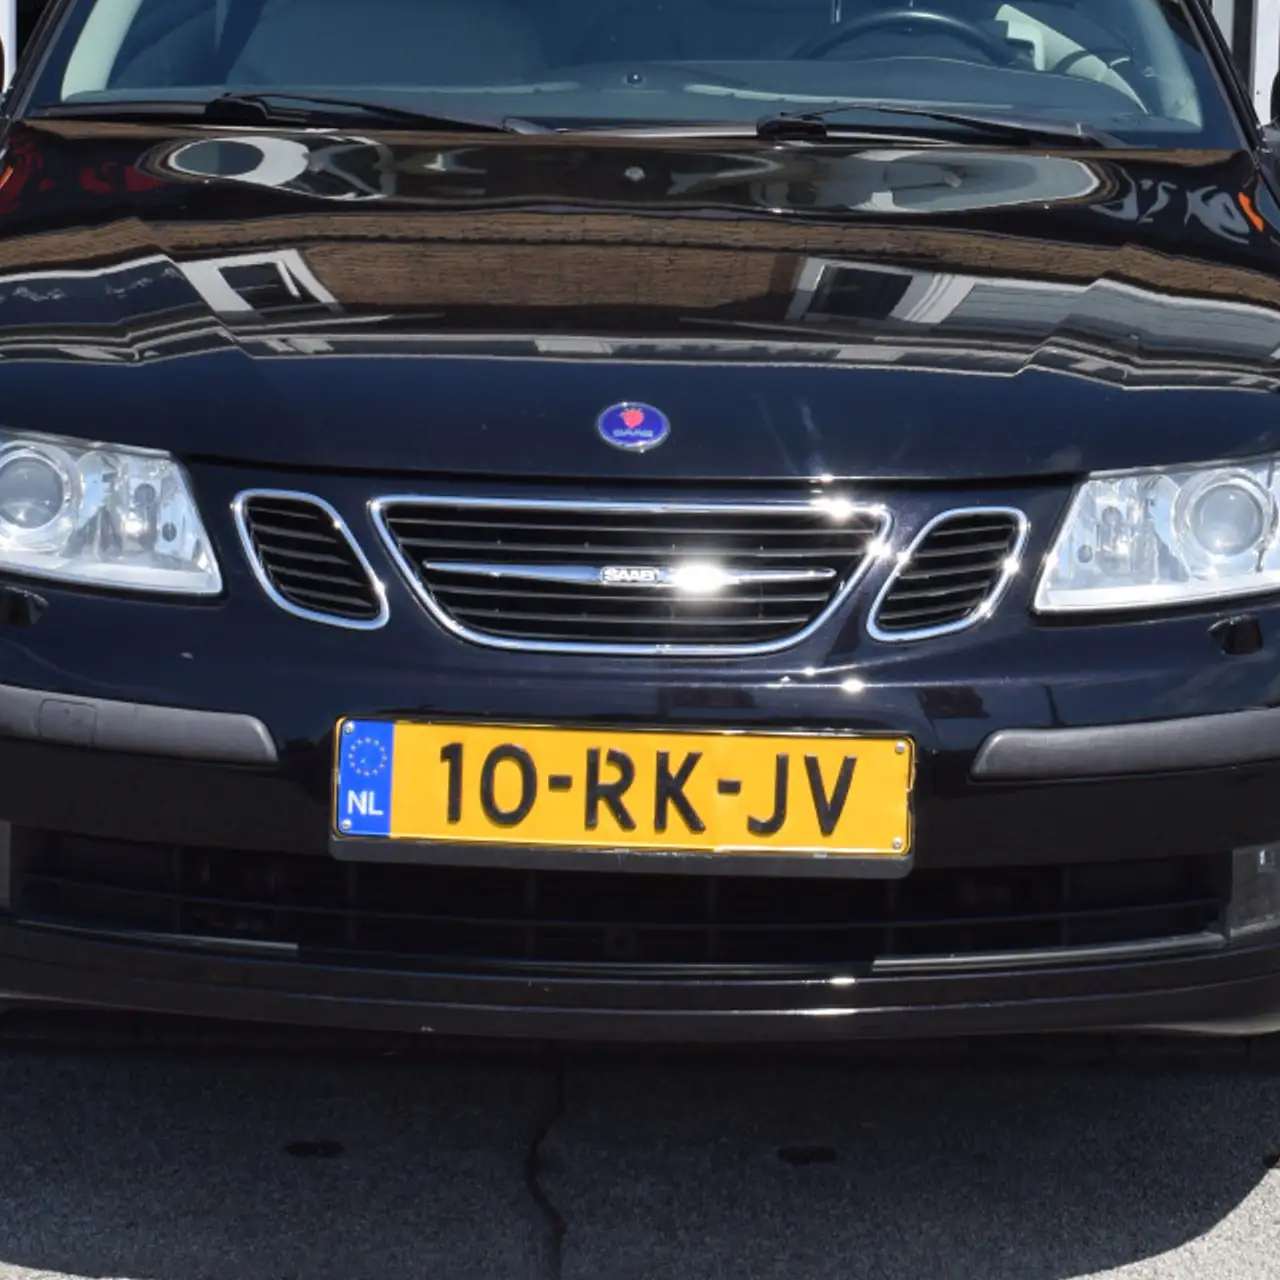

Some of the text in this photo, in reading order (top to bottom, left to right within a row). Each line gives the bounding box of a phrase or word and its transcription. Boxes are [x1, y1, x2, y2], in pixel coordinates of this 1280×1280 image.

[603, 567, 658, 582] SAAB
[439, 742, 859, 837] 10-RK-JV
[346, 790, 384, 818] NL
